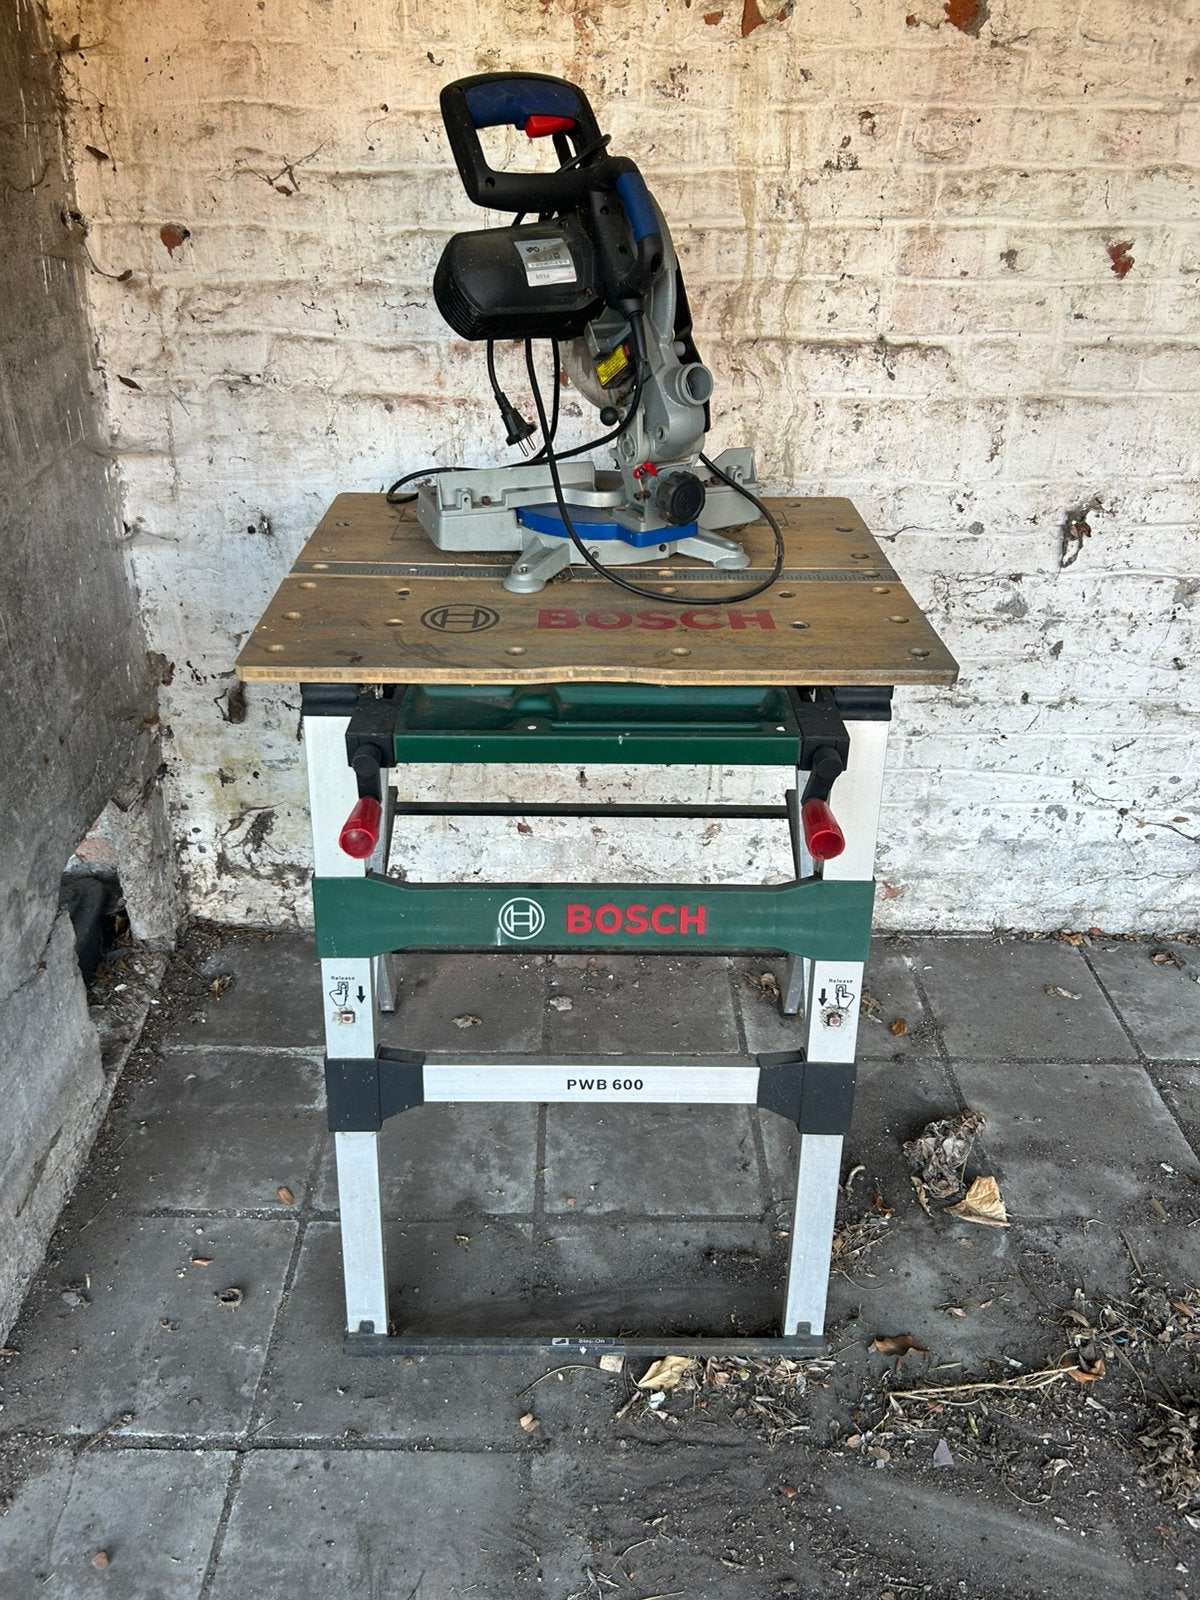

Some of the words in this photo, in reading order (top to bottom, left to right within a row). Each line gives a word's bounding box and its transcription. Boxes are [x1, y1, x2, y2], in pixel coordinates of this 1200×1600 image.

[537, 608, 776, 630] BOSCH
[566, 904, 707, 935] BOSCH
[567, 1079, 607, 1090] PWB
[612, 1079, 644, 1090] 600
